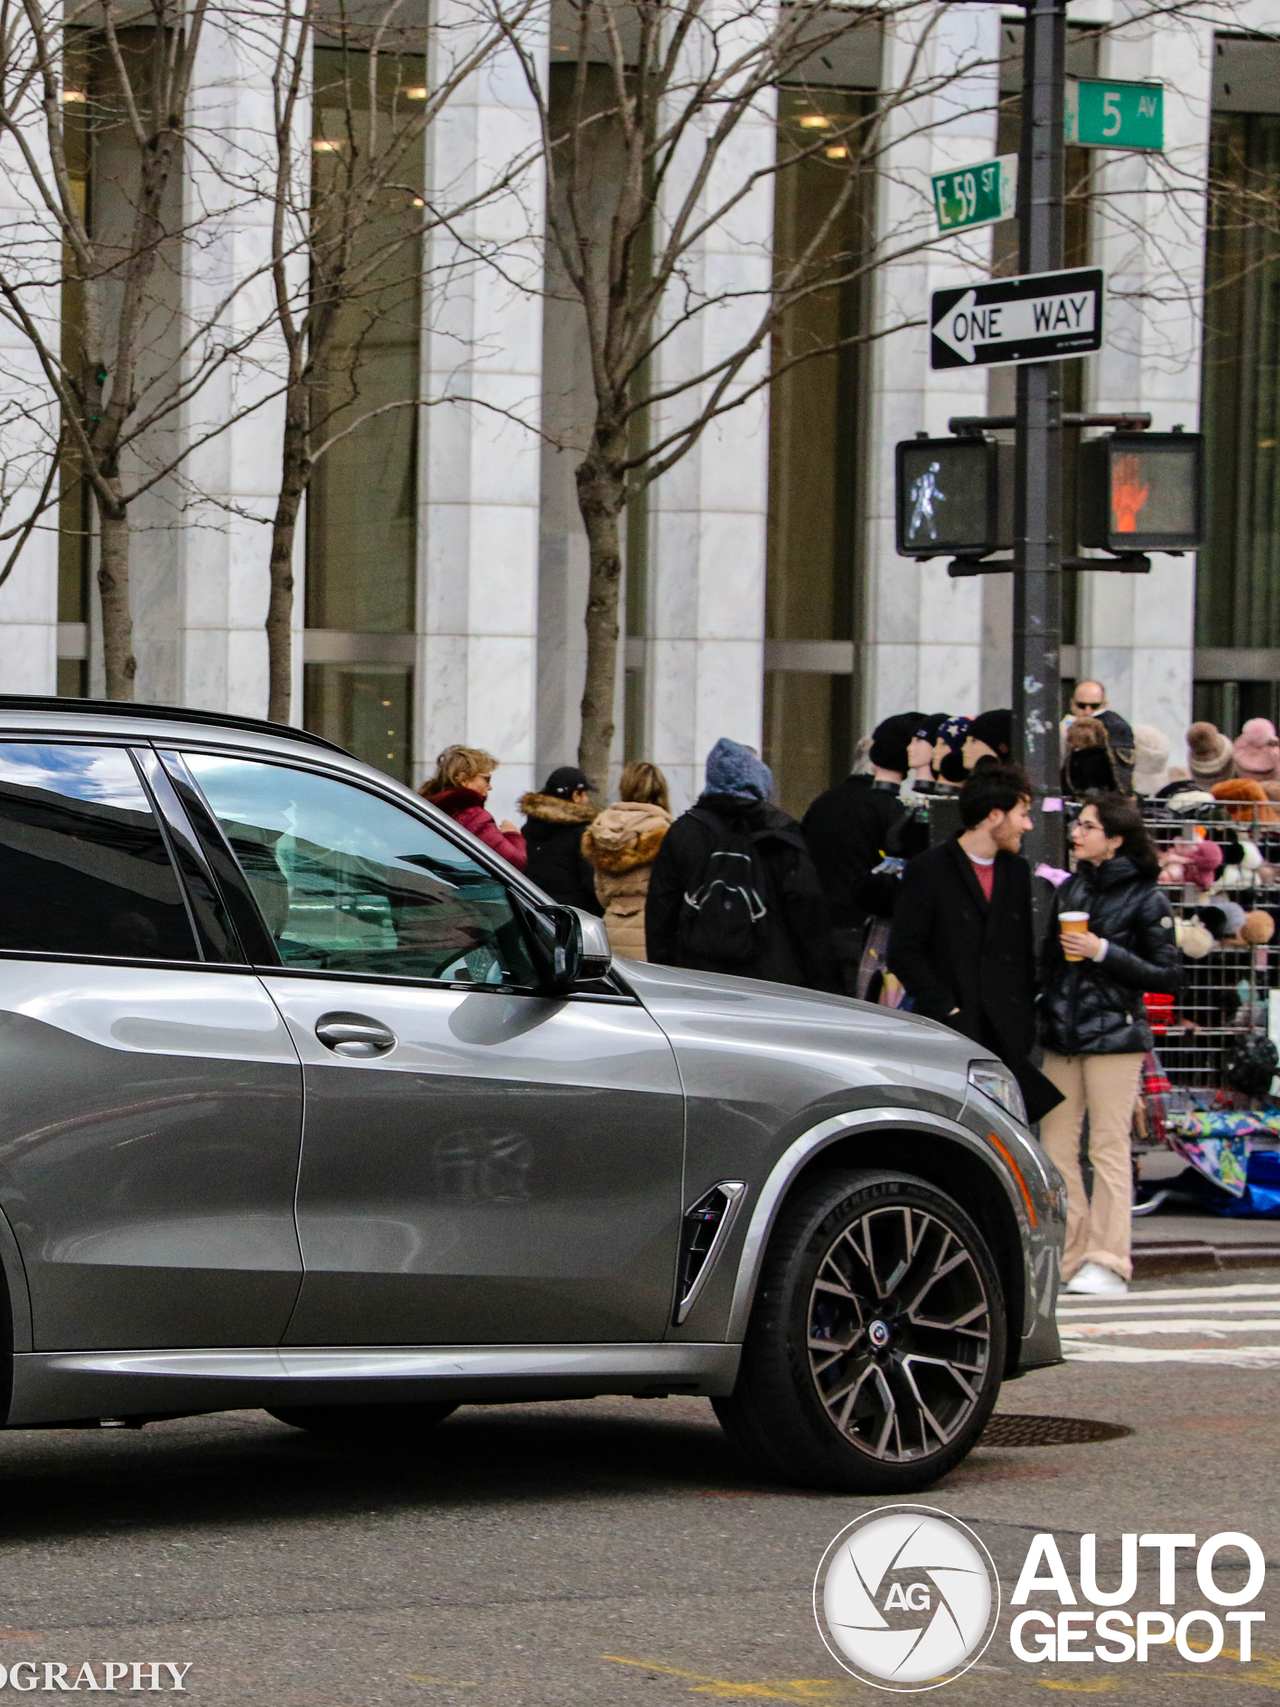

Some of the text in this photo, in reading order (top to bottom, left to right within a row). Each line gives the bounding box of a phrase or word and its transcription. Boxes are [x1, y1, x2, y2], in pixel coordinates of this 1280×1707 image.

[1102, 92, 1157, 137] 5 AV
[936, 167, 996, 225] E 59 ST
[953, 296, 1088, 342] ONE WAY
